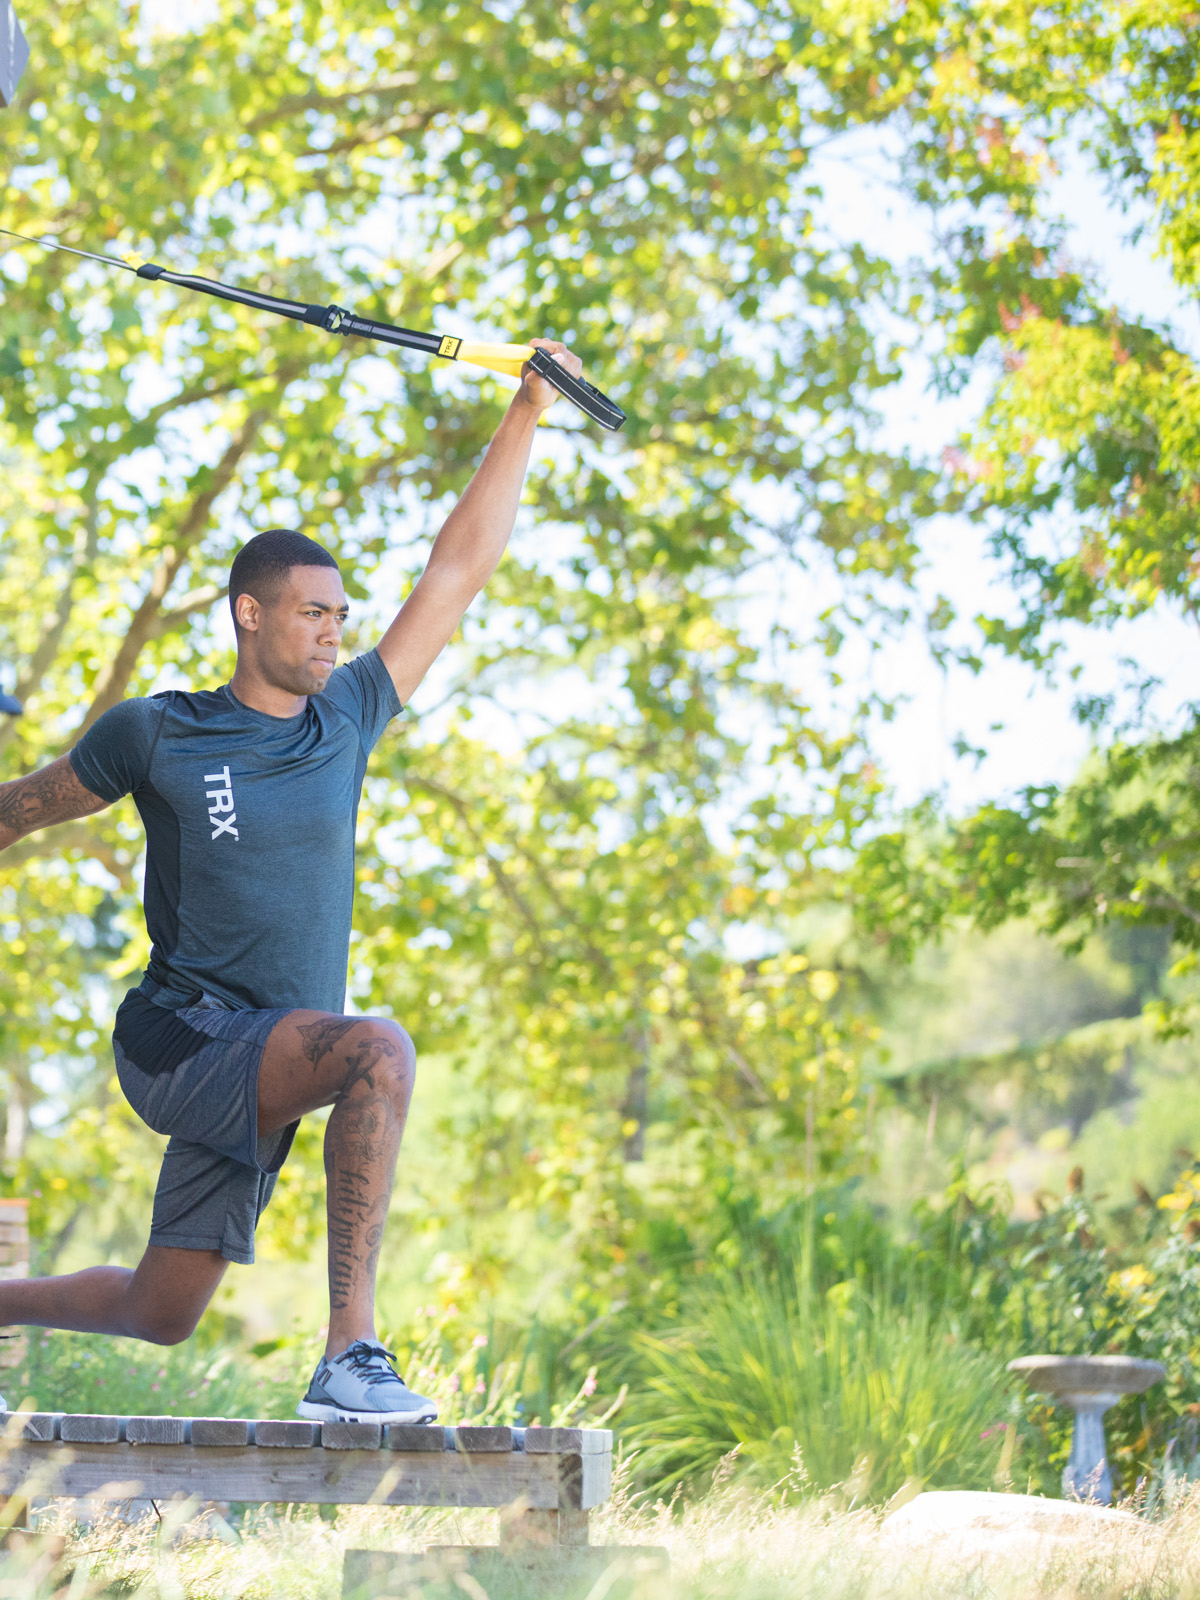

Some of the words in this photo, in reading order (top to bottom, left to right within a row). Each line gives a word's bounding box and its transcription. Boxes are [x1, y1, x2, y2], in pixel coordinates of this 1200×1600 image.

[443, 338, 454, 354] TRX
[203, 765, 239, 841] TRX
[329, 1163, 370, 1310] hilippians
